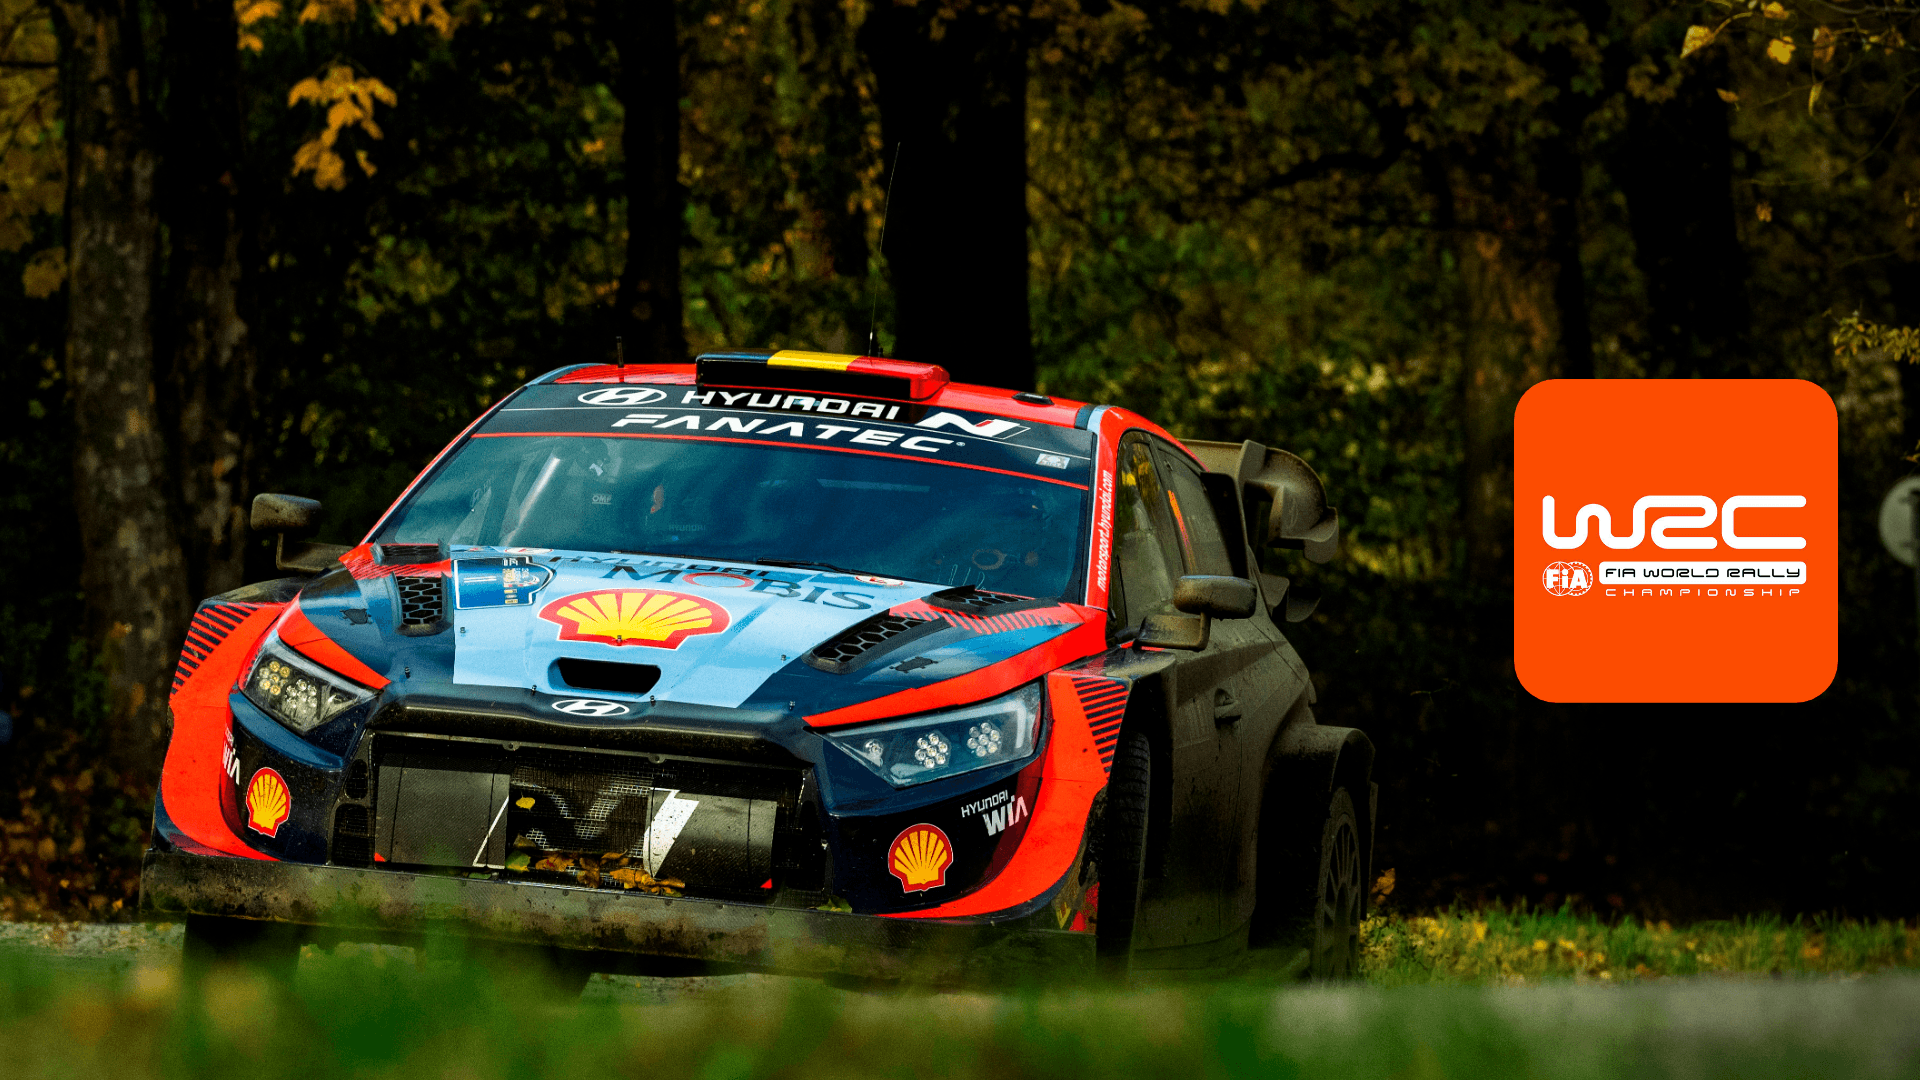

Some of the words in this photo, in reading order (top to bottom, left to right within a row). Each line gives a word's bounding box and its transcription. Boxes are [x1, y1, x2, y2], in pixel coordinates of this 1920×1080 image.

[681, 390, 901, 420] HYUNDAI
[1096, 469, 1113, 593] motorsport.hyundai.com
[549, 555, 771, 577] HYUNDAI
[600, 565, 876, 610] MOBIS
[960, 789, 1009, 818] HYUNDAI
